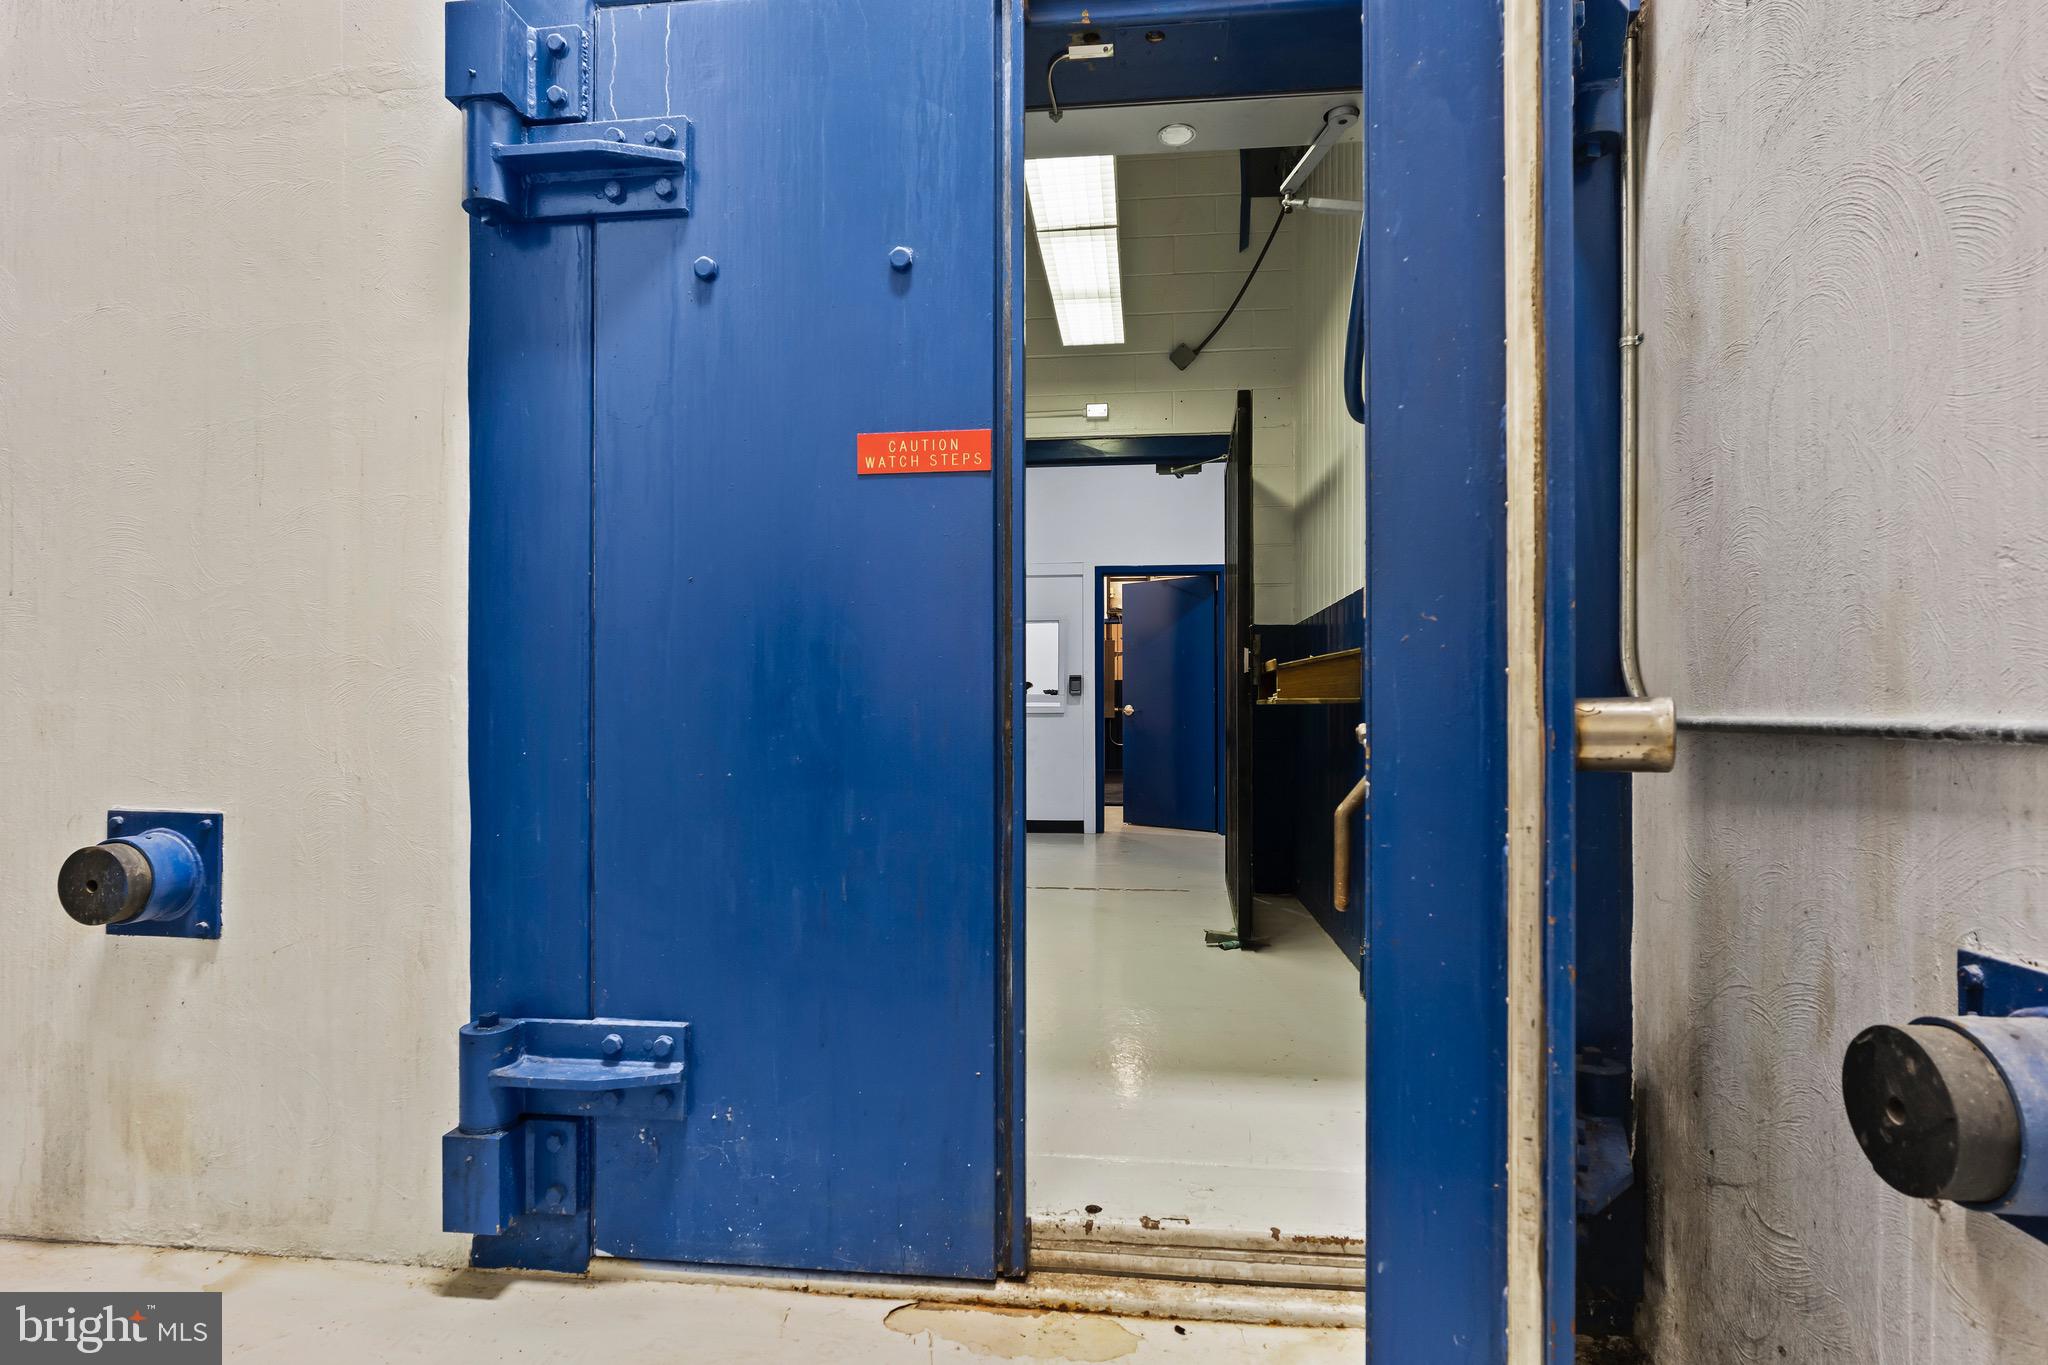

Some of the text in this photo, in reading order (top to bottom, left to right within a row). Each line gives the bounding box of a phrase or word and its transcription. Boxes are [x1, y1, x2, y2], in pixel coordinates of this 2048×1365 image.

[888, 438, 959, 453] CAUTION
[865, 452, 982, 469] WATCH STEPS
